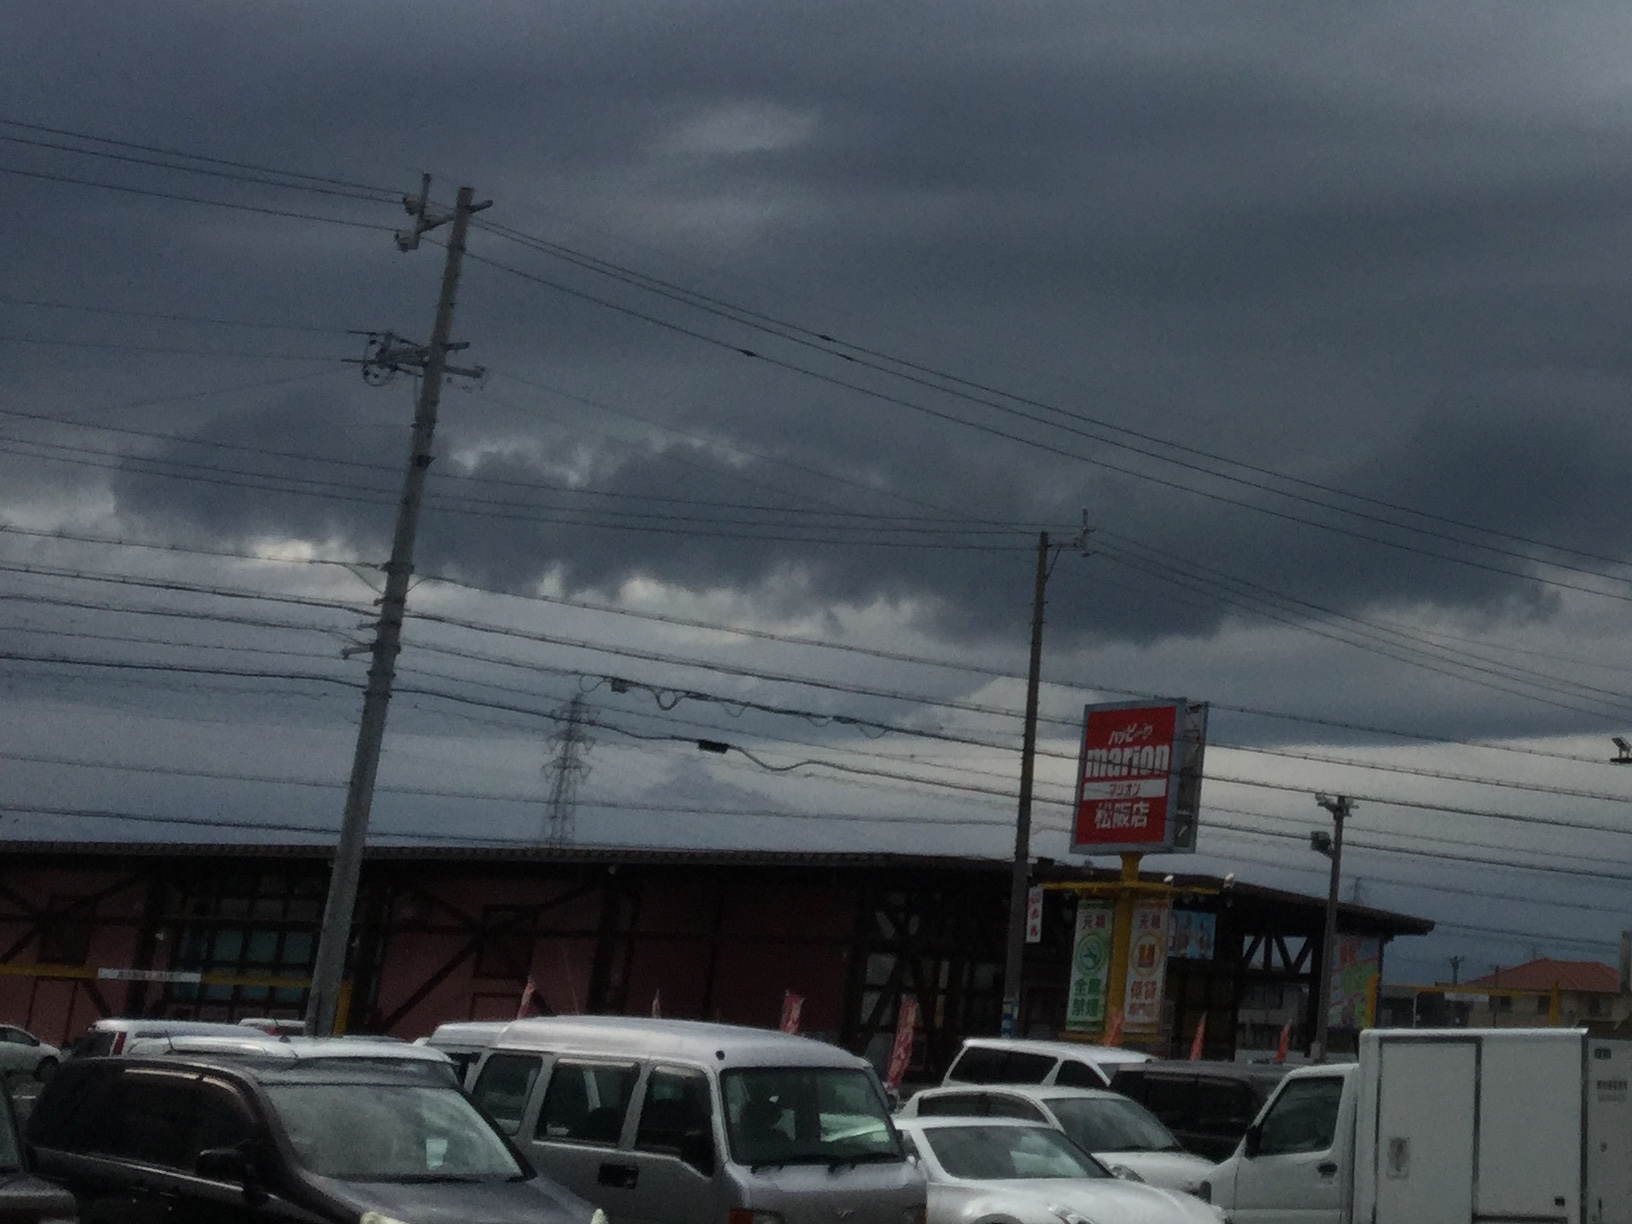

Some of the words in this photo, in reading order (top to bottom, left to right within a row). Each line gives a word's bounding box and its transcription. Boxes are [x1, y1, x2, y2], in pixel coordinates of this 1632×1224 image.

[1084, 744, 1171, 779] marion
[1094, 800, 1150, 830] 松阪店
